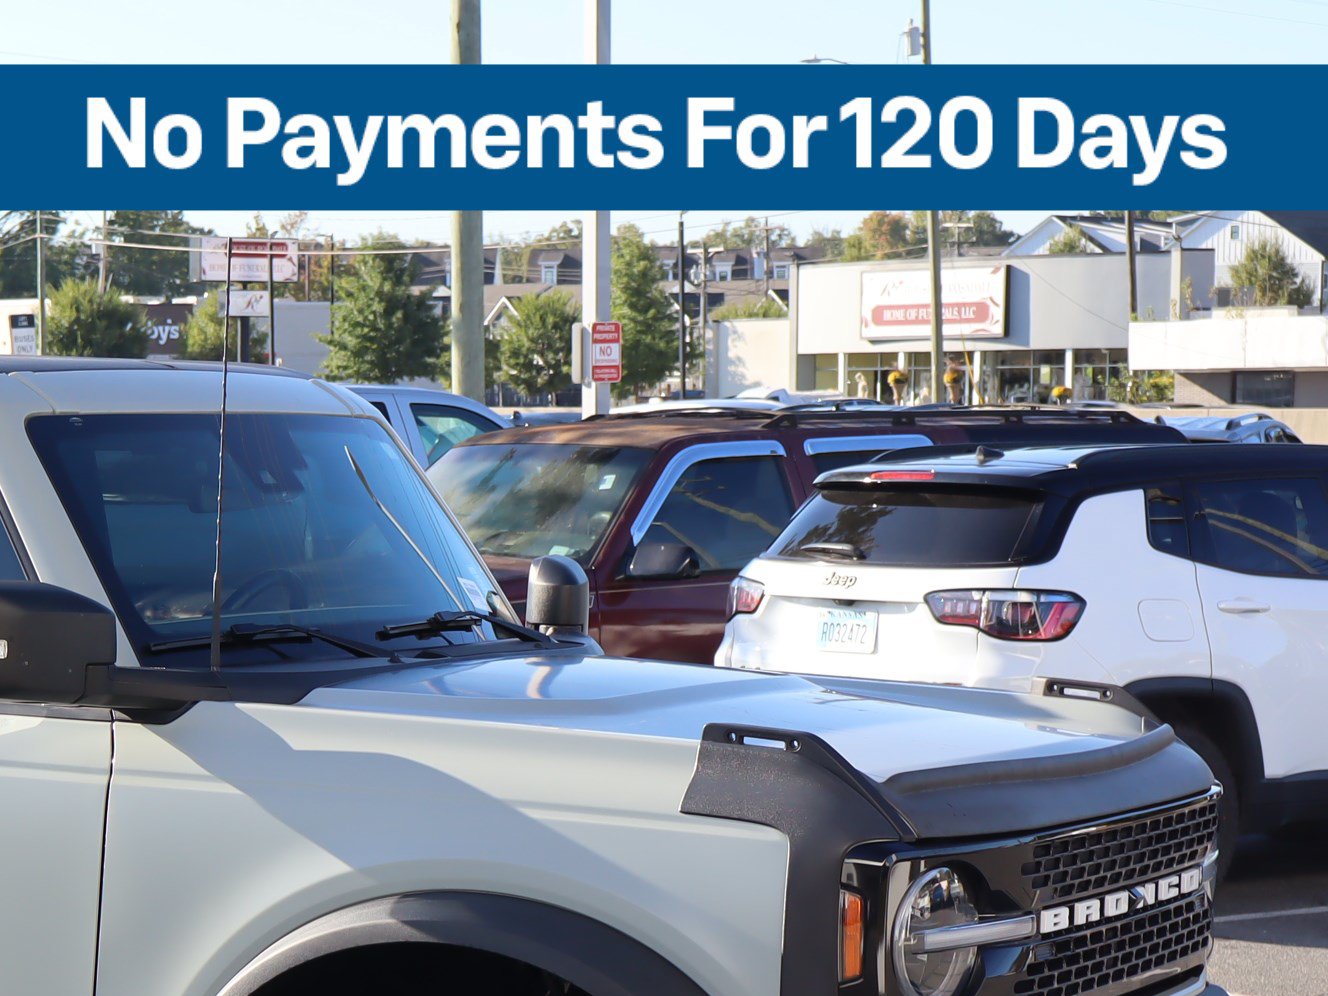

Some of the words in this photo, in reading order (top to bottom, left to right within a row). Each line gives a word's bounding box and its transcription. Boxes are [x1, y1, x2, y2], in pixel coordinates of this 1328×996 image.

[883, 309, 905, 321] HOME
[906, 308, 918, 320] OF
[599, 346, 612, 357] NO
[824, 572, 857, 589] Jeep
[1039, 868, 1200, 934] BRONCO
